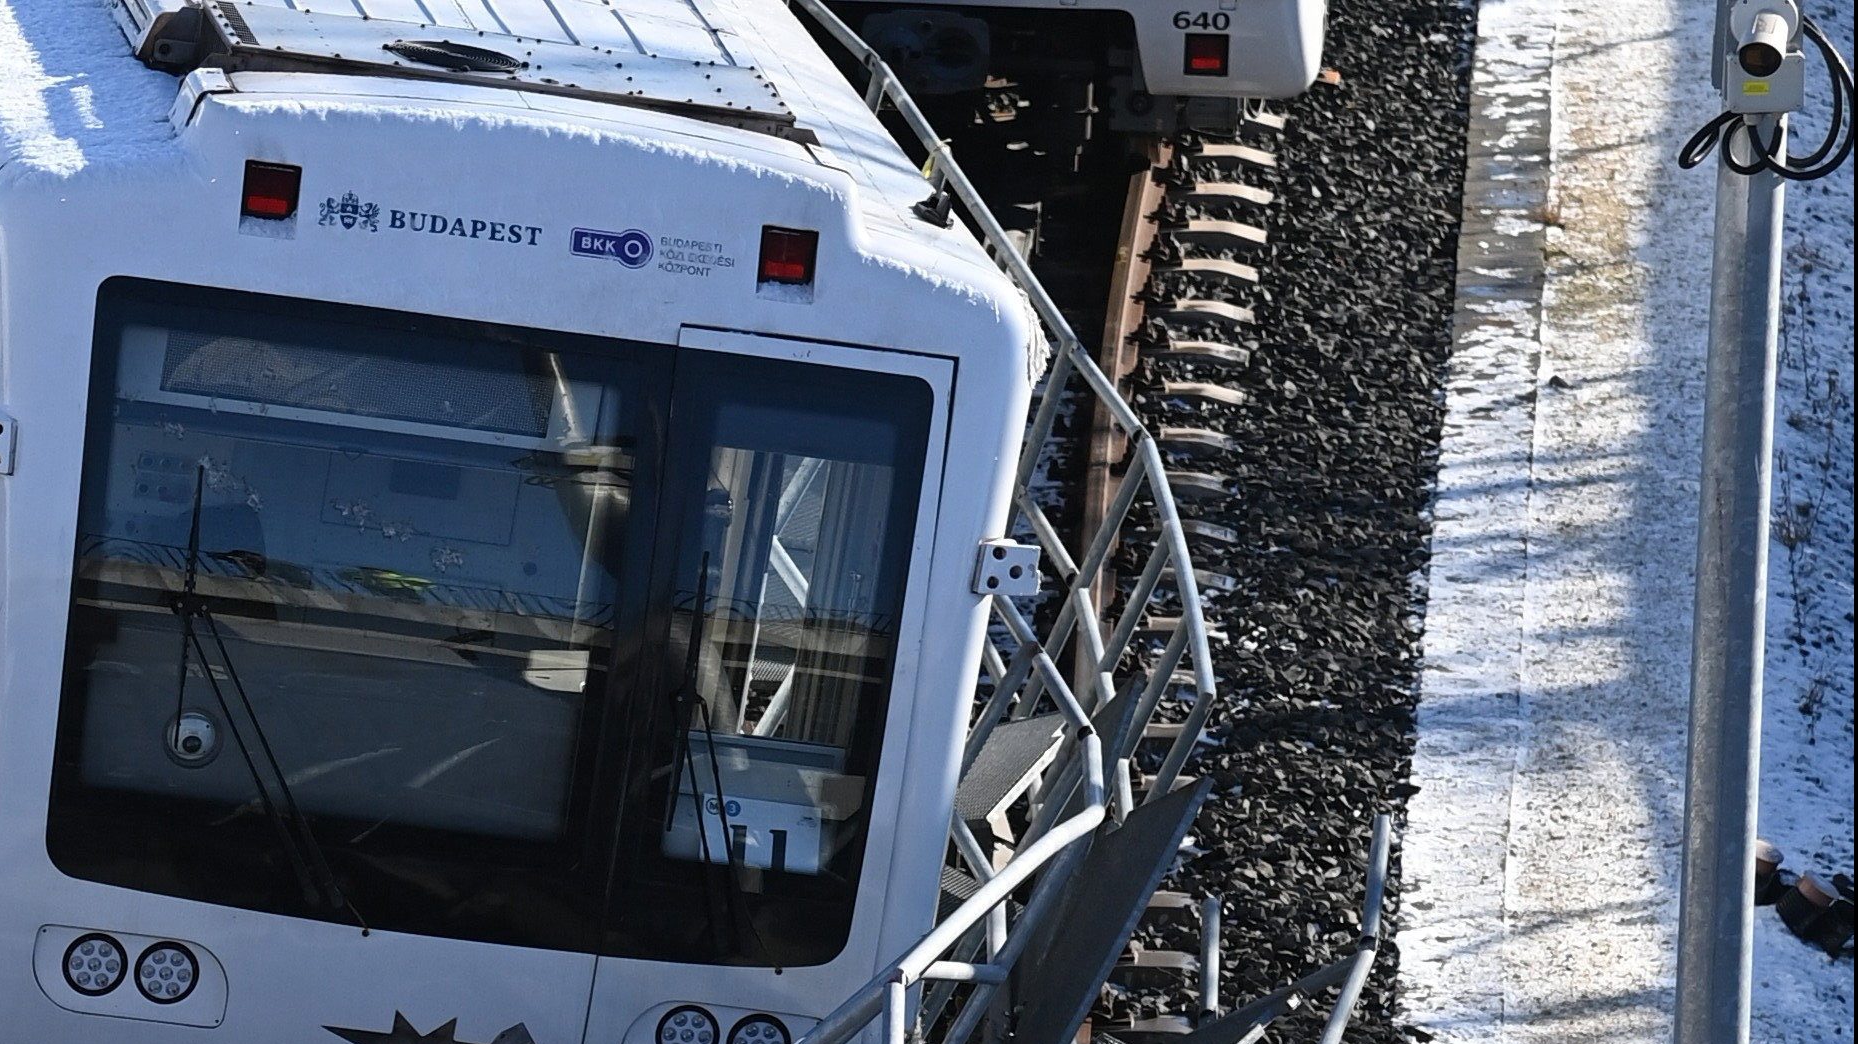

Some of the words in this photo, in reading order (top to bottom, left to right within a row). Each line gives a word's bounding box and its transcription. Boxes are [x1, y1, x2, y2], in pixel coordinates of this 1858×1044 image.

[1173, 11, 1230, 31] 640
[388, 209, 543, 246] BUDAPEST
[581, 236, 616, 253] BKK
[660, 236, 722, 253] BUDAPESTI
[657, 261, 711, 277] KÖZPONT
